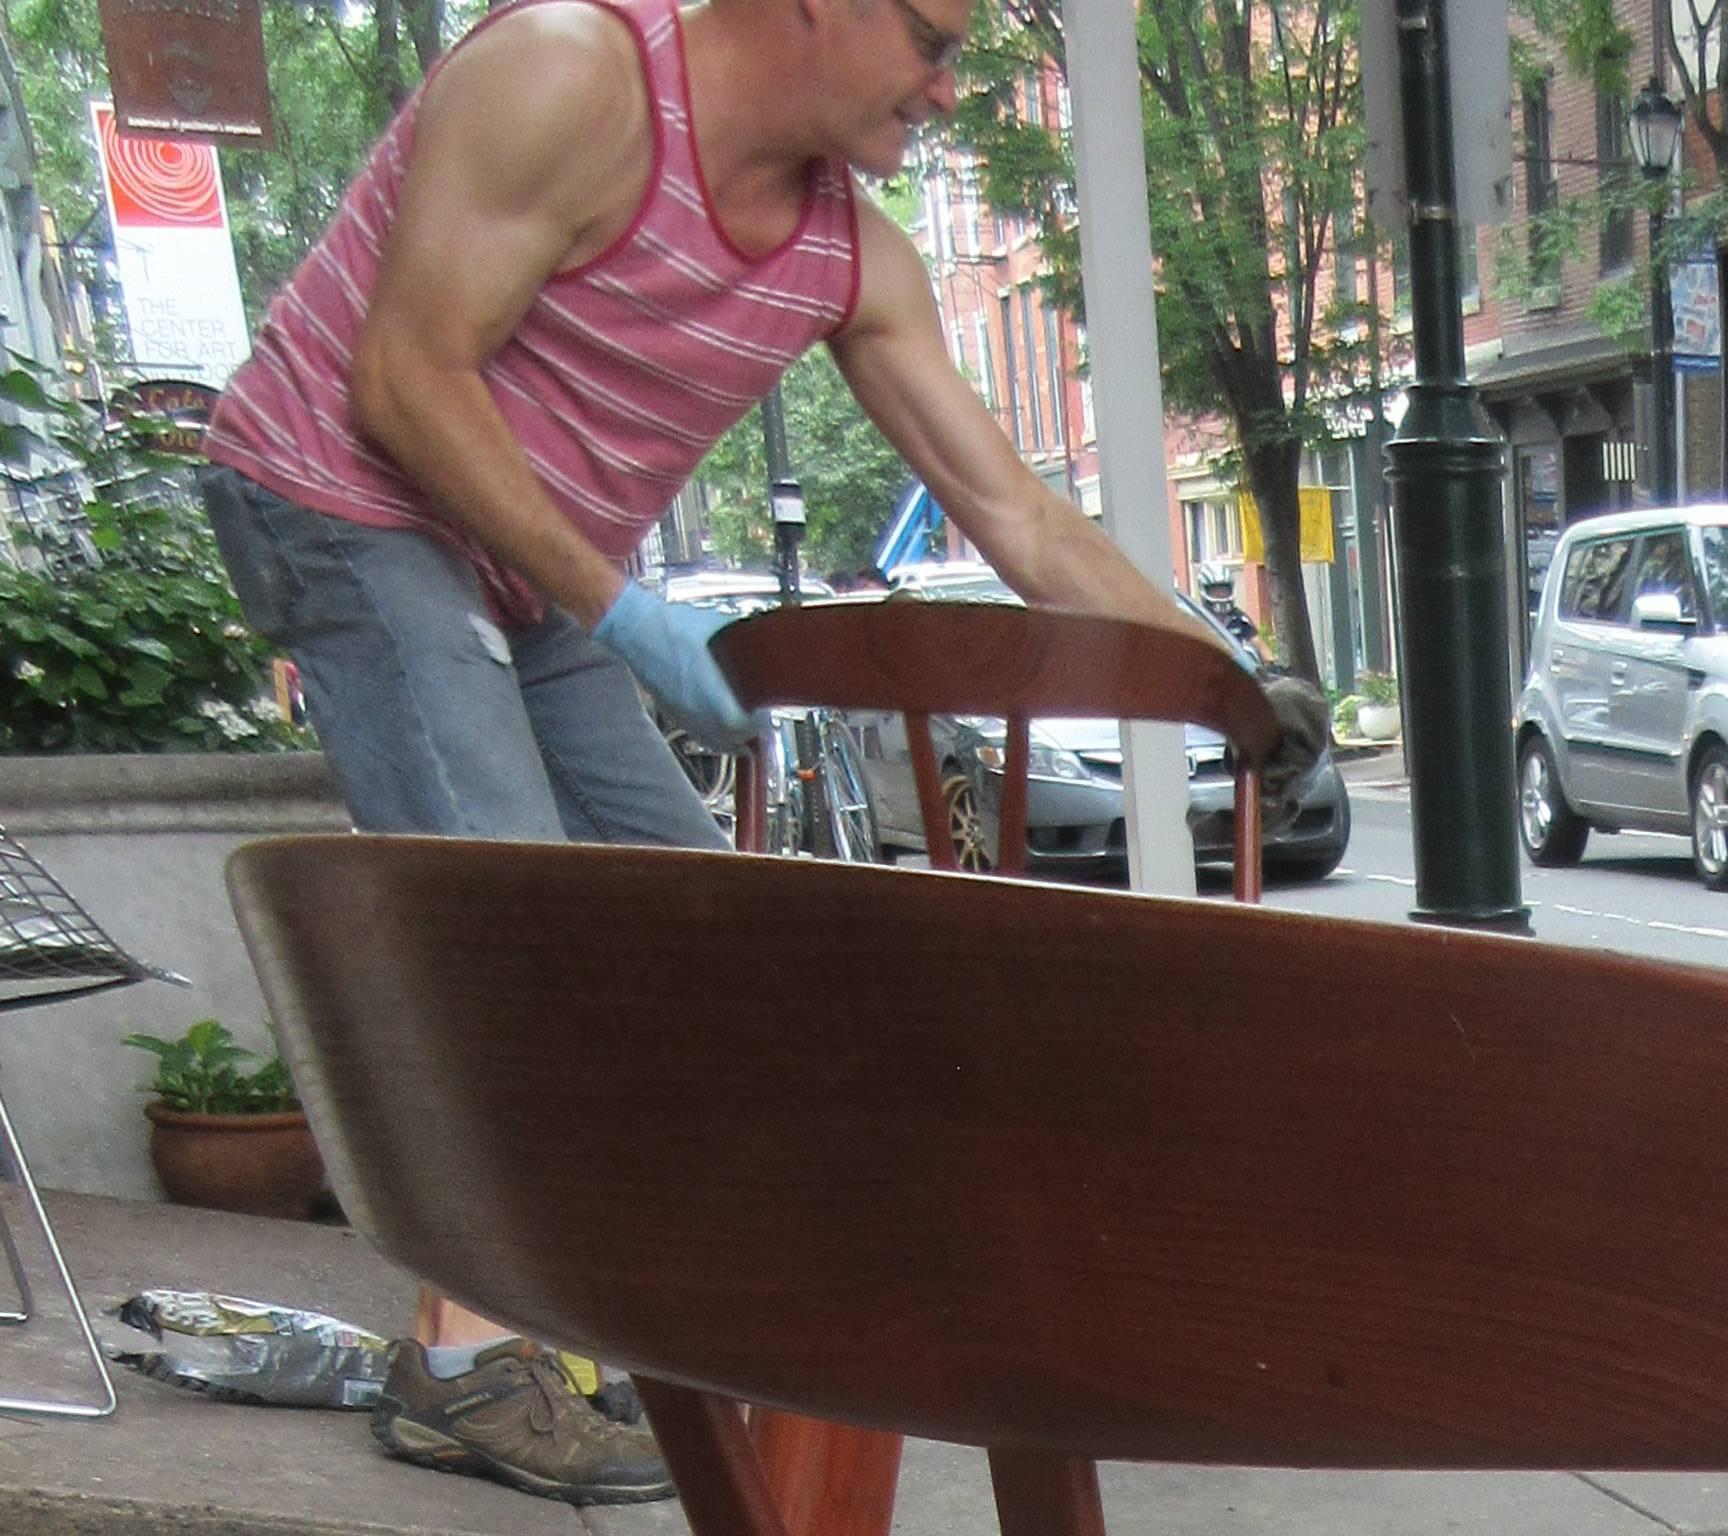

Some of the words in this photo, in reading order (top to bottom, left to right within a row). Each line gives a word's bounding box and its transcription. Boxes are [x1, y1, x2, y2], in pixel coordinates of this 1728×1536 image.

[138, 297, 178, 316] THE
[141, 319, 226, 338] CENTER
[144, 340, 188, 359] FOR
[200, 341, 236, 361] ART
